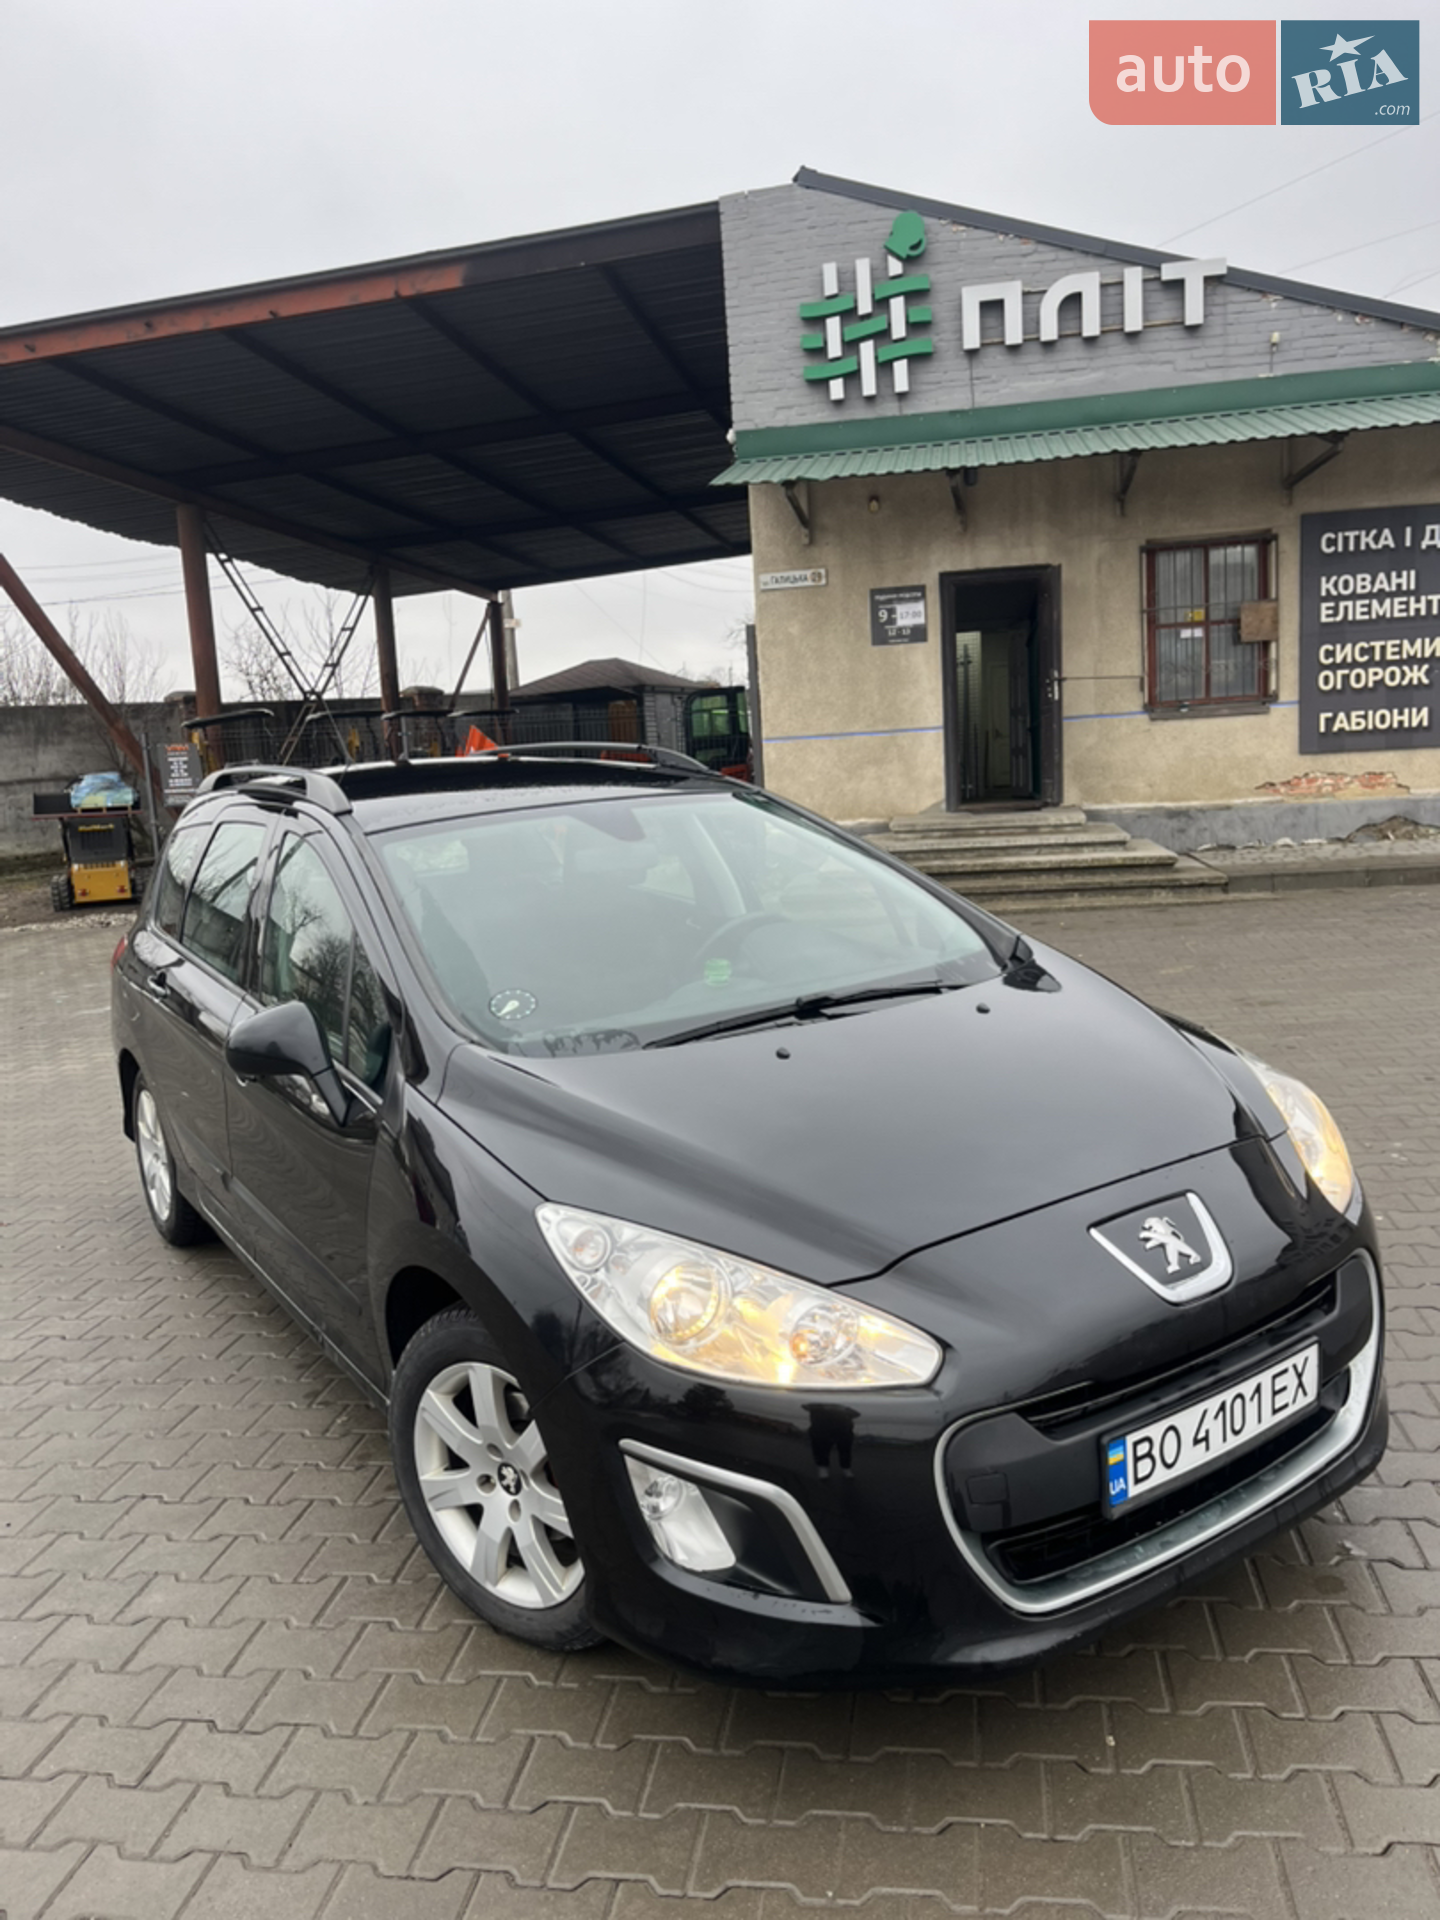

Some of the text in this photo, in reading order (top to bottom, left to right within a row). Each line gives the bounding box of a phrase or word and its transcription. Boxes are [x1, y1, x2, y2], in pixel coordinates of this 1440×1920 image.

[961, 257, 1227, 351] ПЛІТ
[1319, 527, 1396, 554] СІТКА
[1404, 525, 1413, 548] І
[1319, 569, 1416, 597] КОВАНІ
[1319, 594, 1440, 624] ЕЛЕМЕНТ
[1318, 636, 1440, 665] СИСТЕМИ
[1317, 663, 1430, 691] ОГОРОЖ
[1318, 706, 1430, 733] ГАБІОНИ
[1132, 1355, 1309, 1486] BO 4101 EX
[1109, 1476, 1127, 1496] UA
